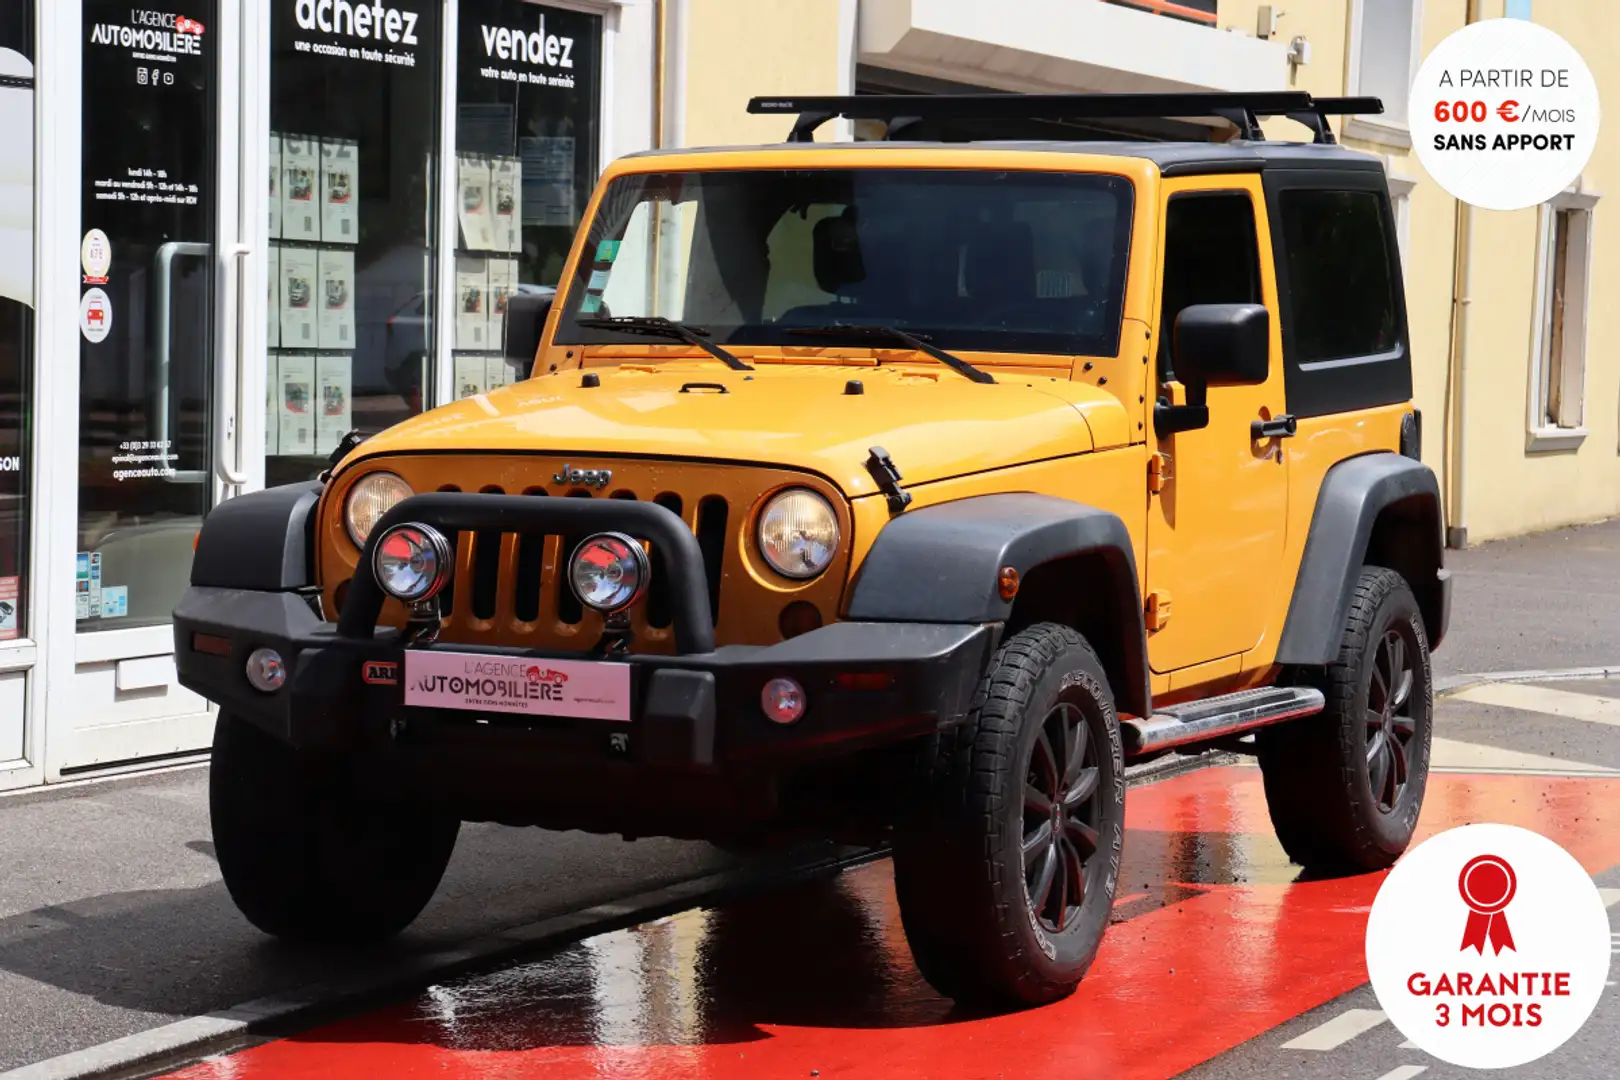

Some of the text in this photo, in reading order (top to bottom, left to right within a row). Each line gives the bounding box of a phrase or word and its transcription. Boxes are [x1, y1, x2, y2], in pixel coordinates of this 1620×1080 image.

[131, 8, 176, 28] L'AGENCE
[295, 0, 418, 45] achetez
[481, 13, 574, 68] vendez
[294, 40, 416, 67] une occasion en toute sécurité
[480, 66, 575, 88] votre auto en toute sérénité
[553, 464, 612, 488] Jeep
[464, 660, 526, 679] L'AGENCE
